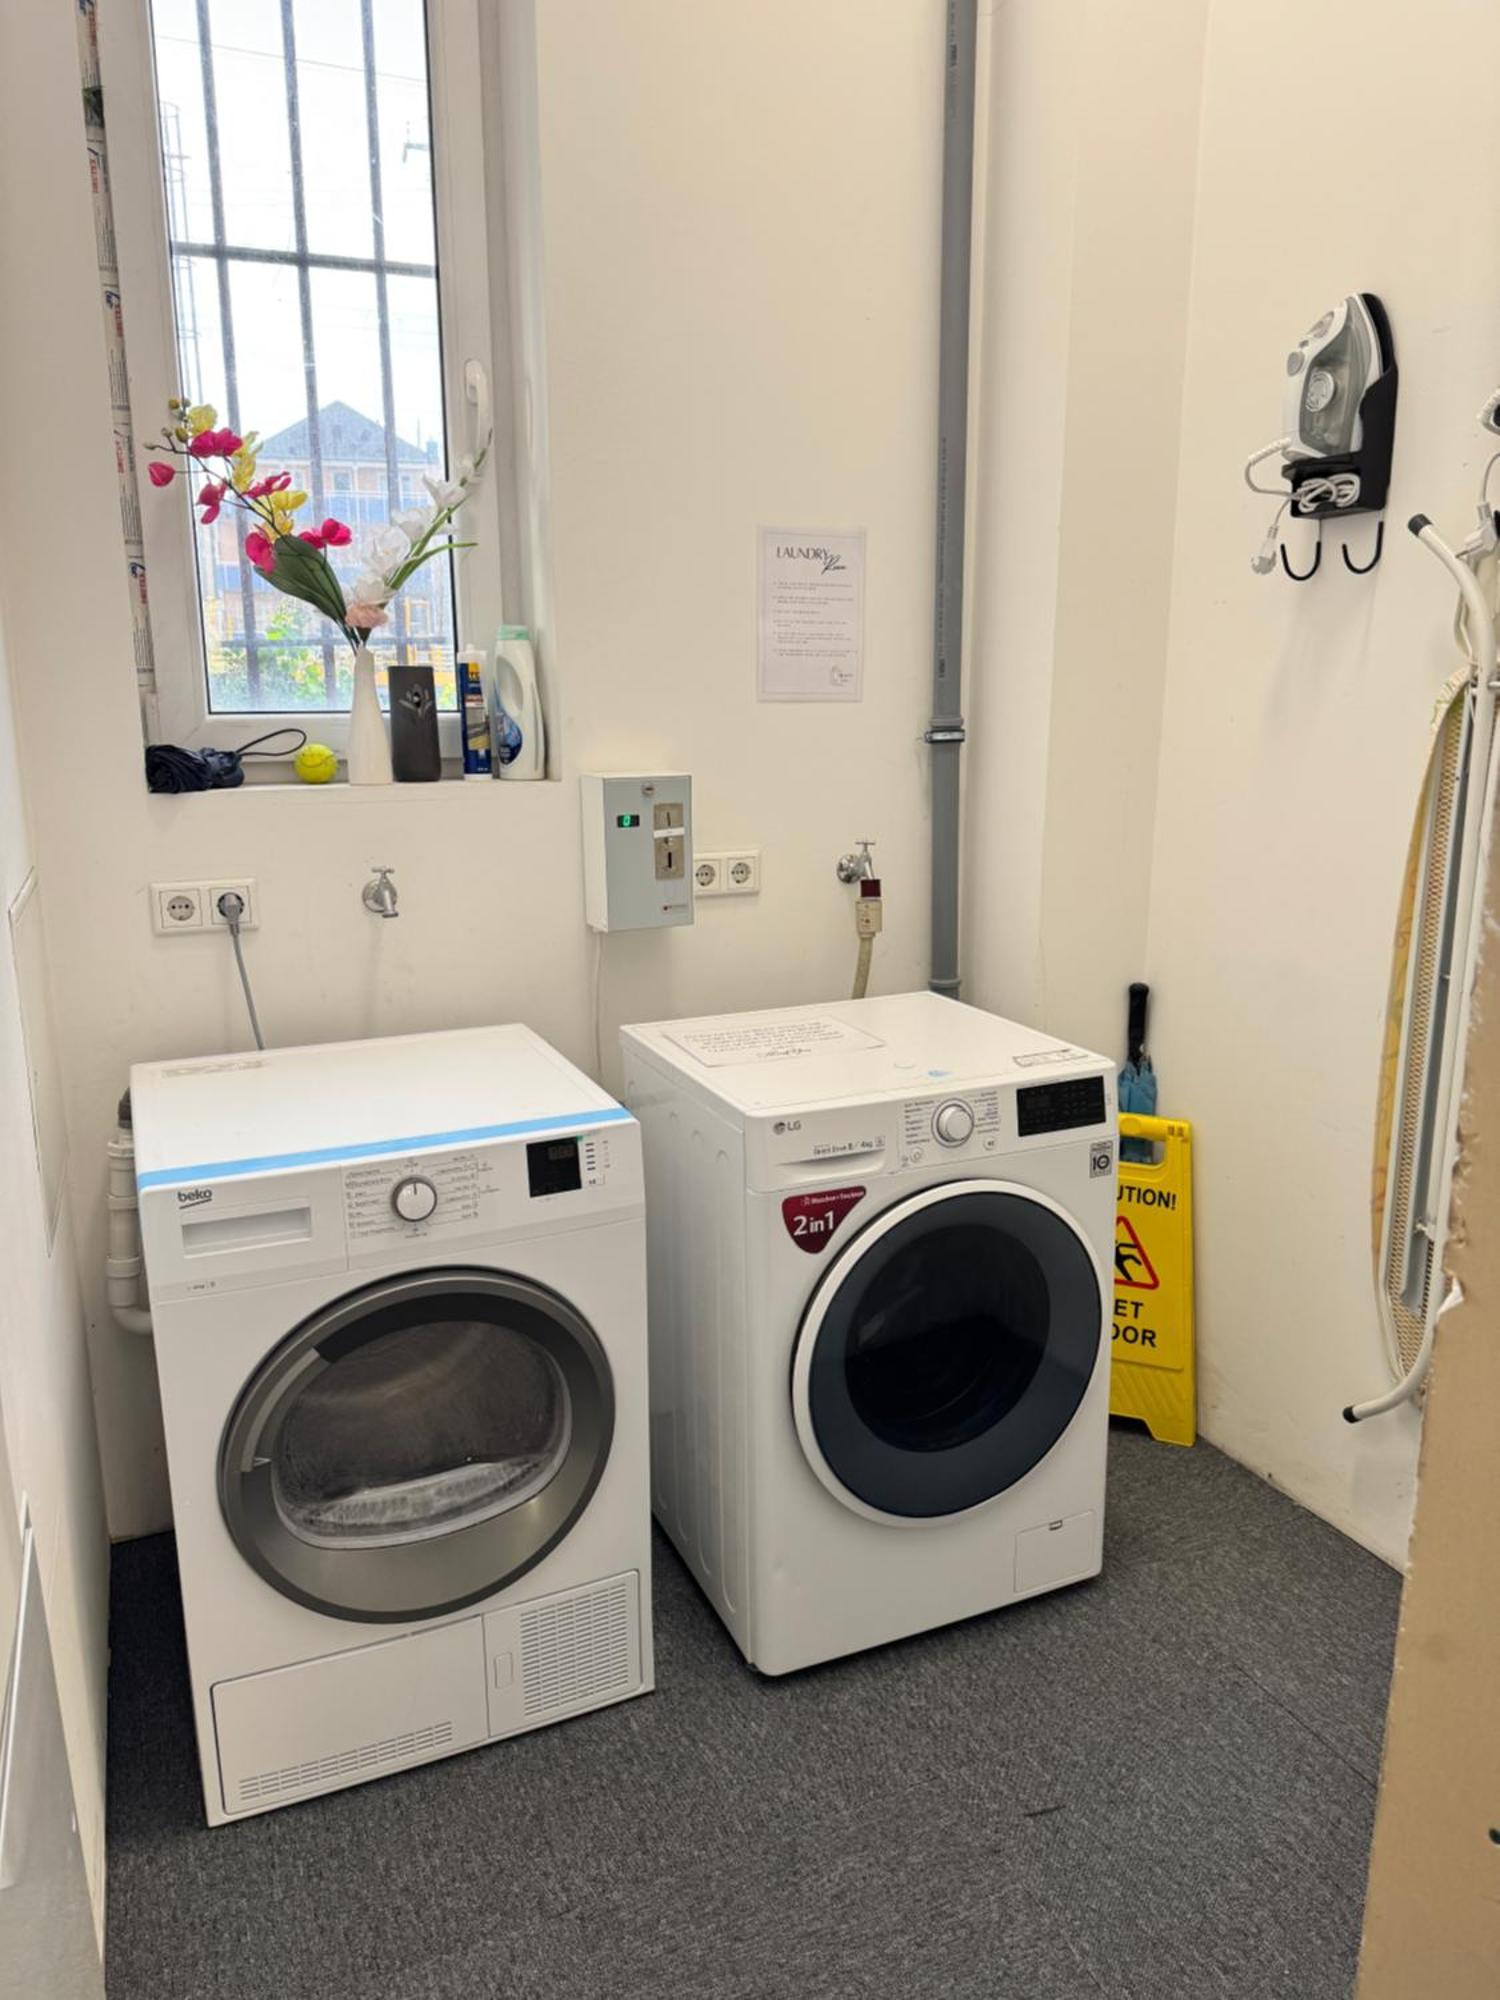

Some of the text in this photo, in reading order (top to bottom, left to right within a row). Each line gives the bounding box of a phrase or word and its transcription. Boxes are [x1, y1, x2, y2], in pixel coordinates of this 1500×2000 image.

[776, 546, 830, 561] LAUNDRY
[787, 1121, 802, 1131] LG
[177, 1188, 213, 1203] beko
